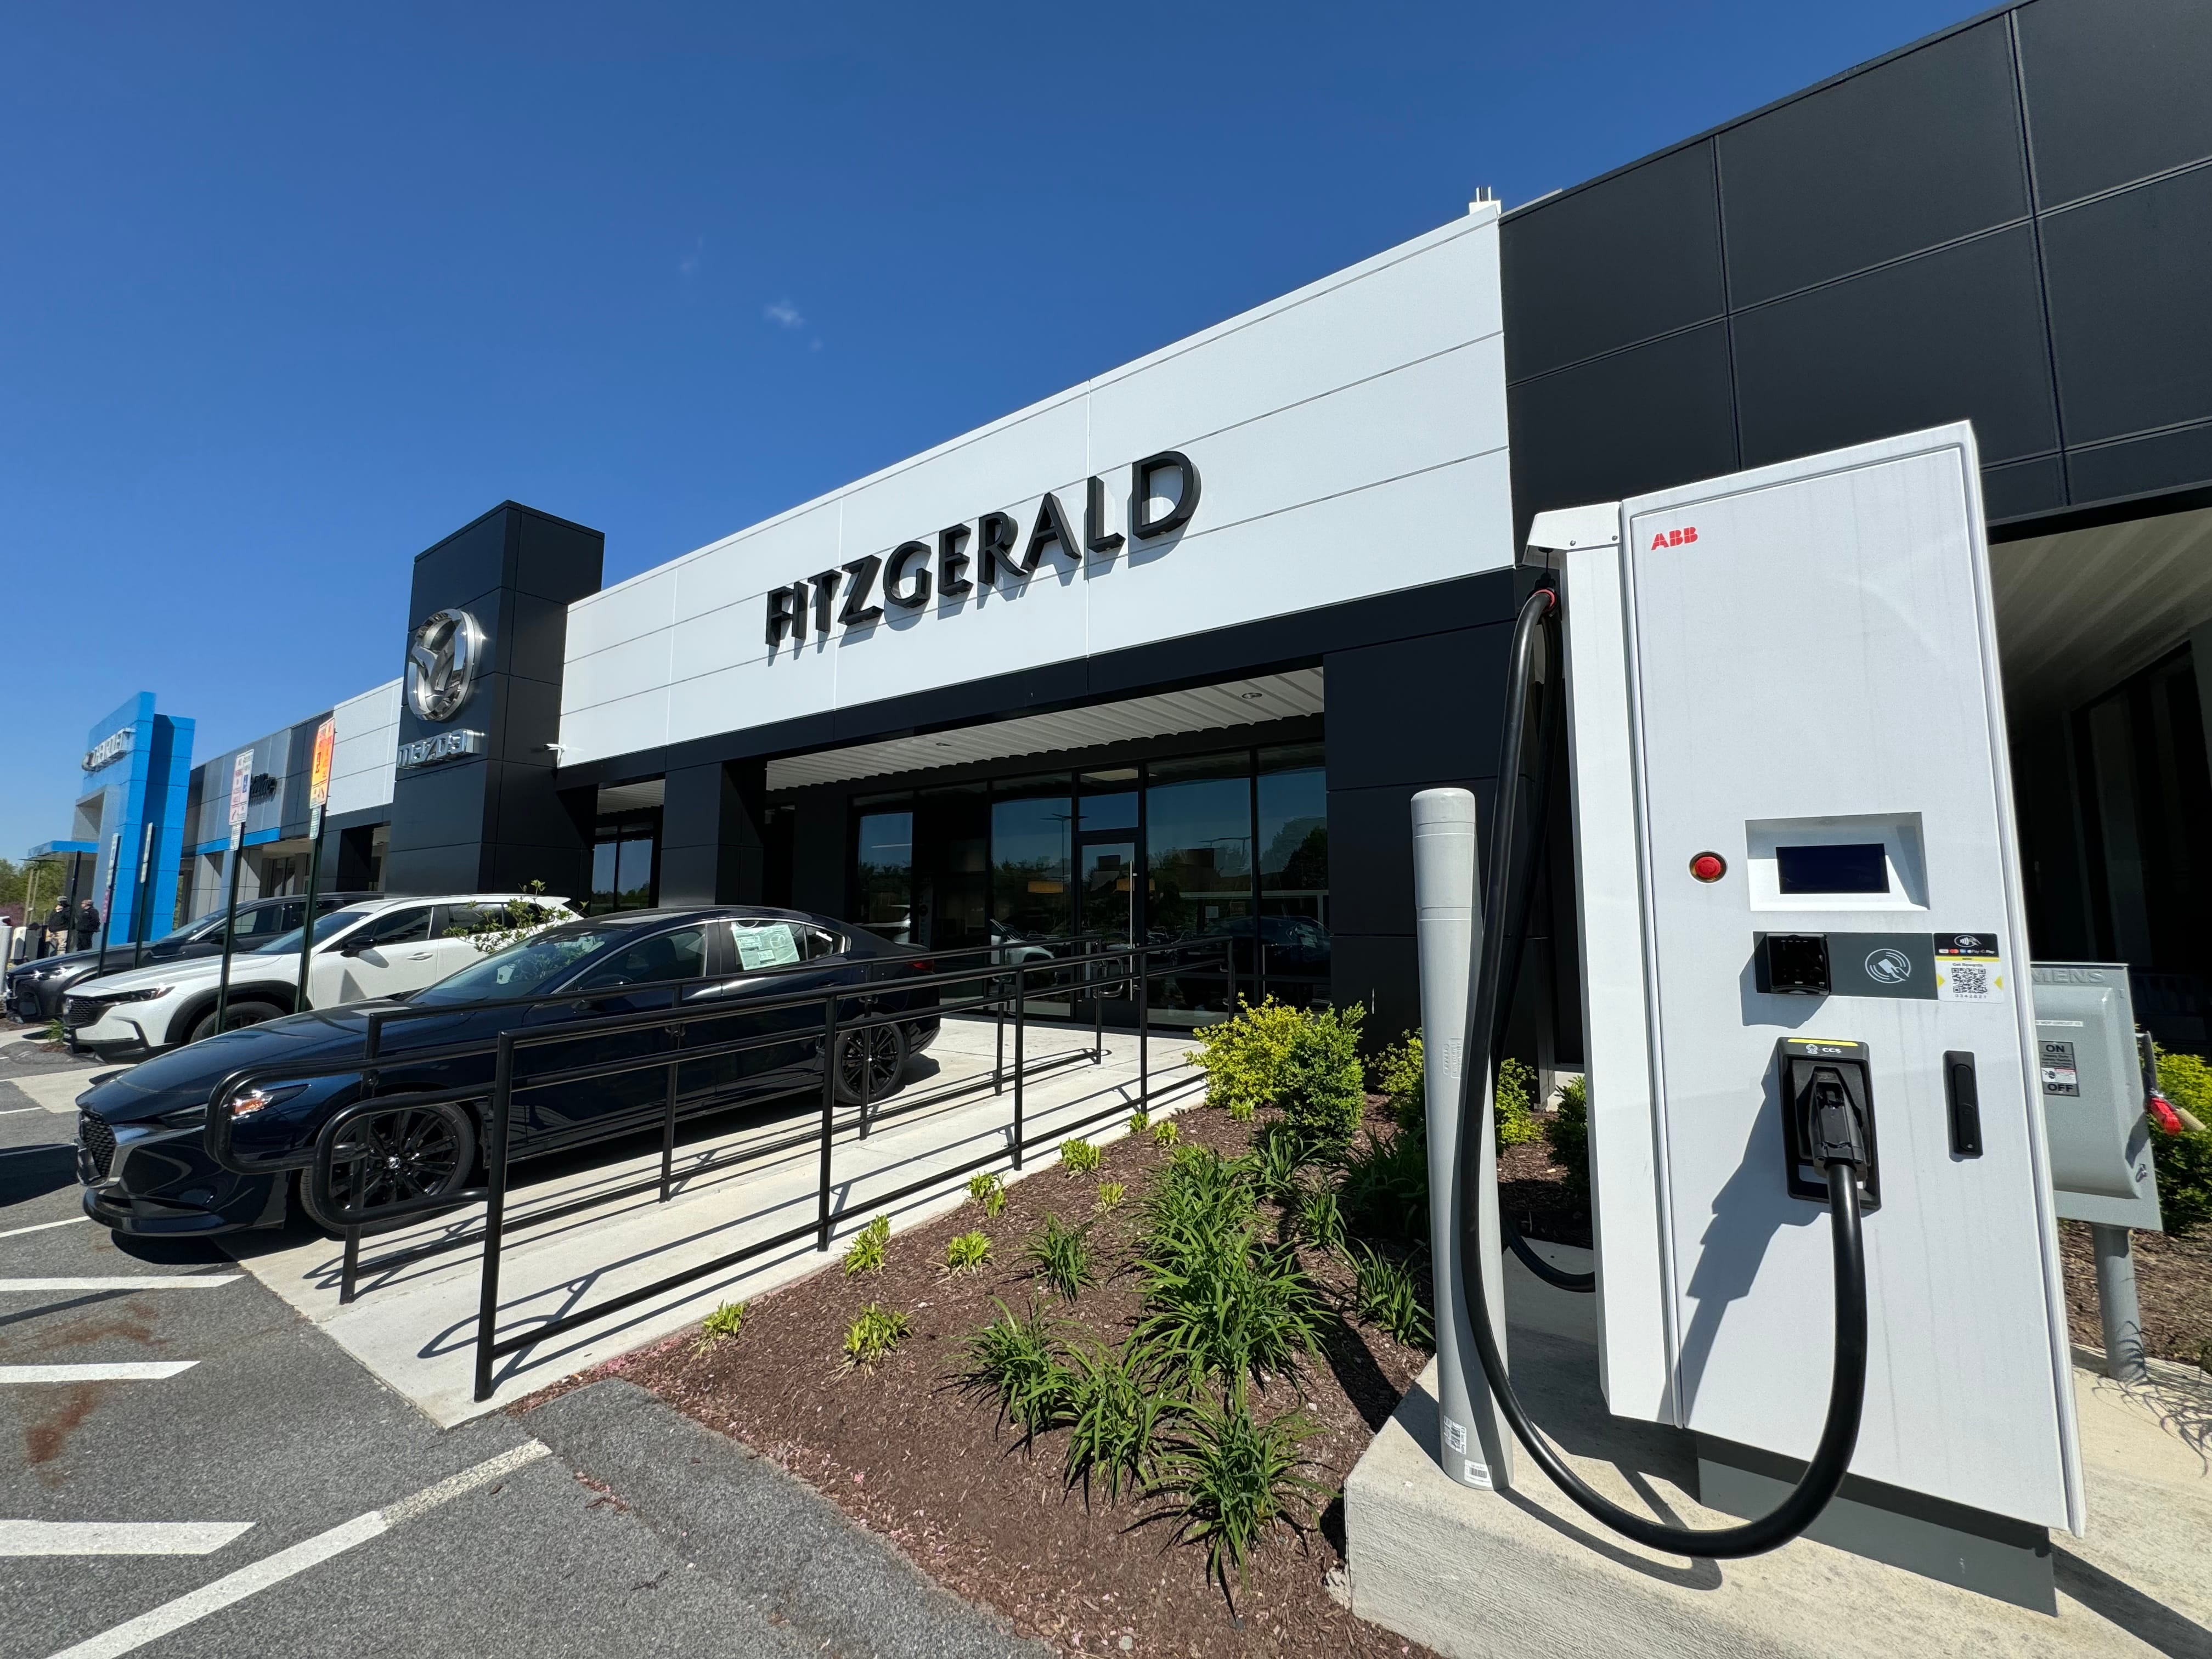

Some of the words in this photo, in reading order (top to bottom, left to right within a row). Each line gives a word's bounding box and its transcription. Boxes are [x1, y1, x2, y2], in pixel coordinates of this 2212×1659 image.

[1651, 527, 1698, 550] ABB
[765, 450, 1202, 647] FITZGERALD
[2030, 969, 2105, 984] MENS
[2045, 1044, 2064, 1053] ON
[2047, 1083, 2073, 1092] OFF
